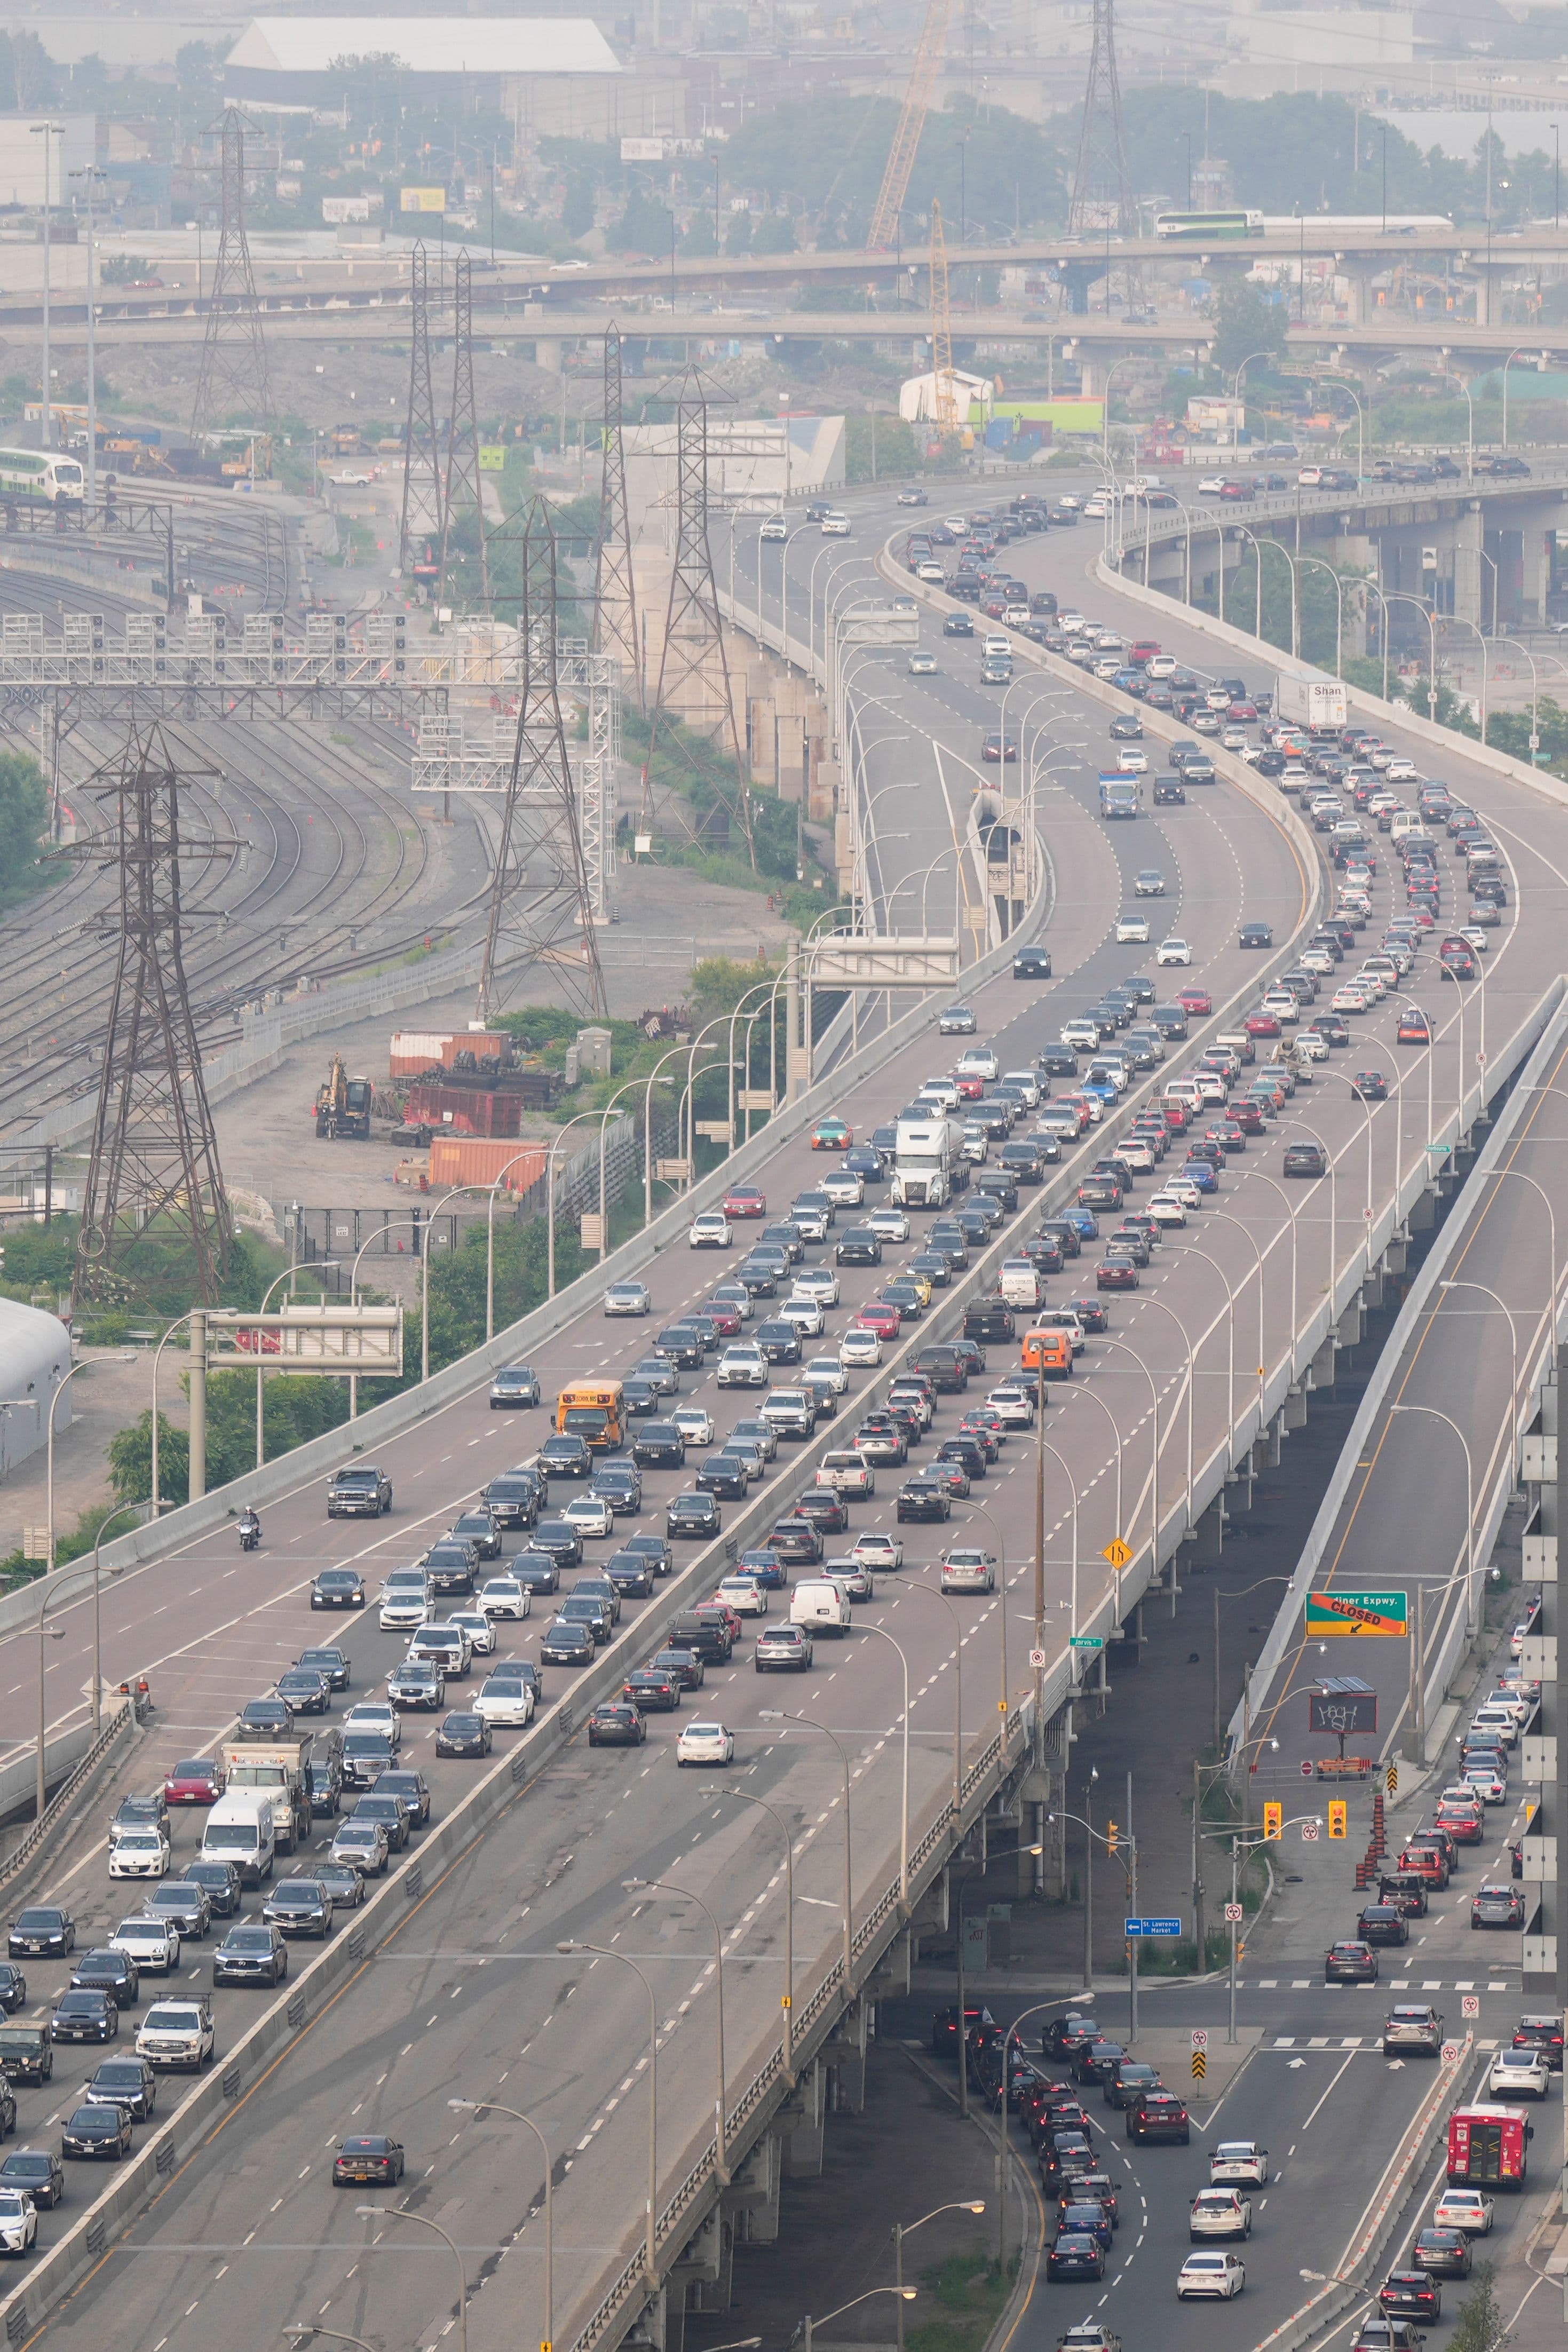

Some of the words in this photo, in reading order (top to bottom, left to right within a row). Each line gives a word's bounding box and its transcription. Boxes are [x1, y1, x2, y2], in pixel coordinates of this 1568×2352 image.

[1314, 686, 1341, 695] Shan
[1364, 1597, 1397, 1606] Expwy.
[1331, 1601, 1381, 1626] CLOSED
